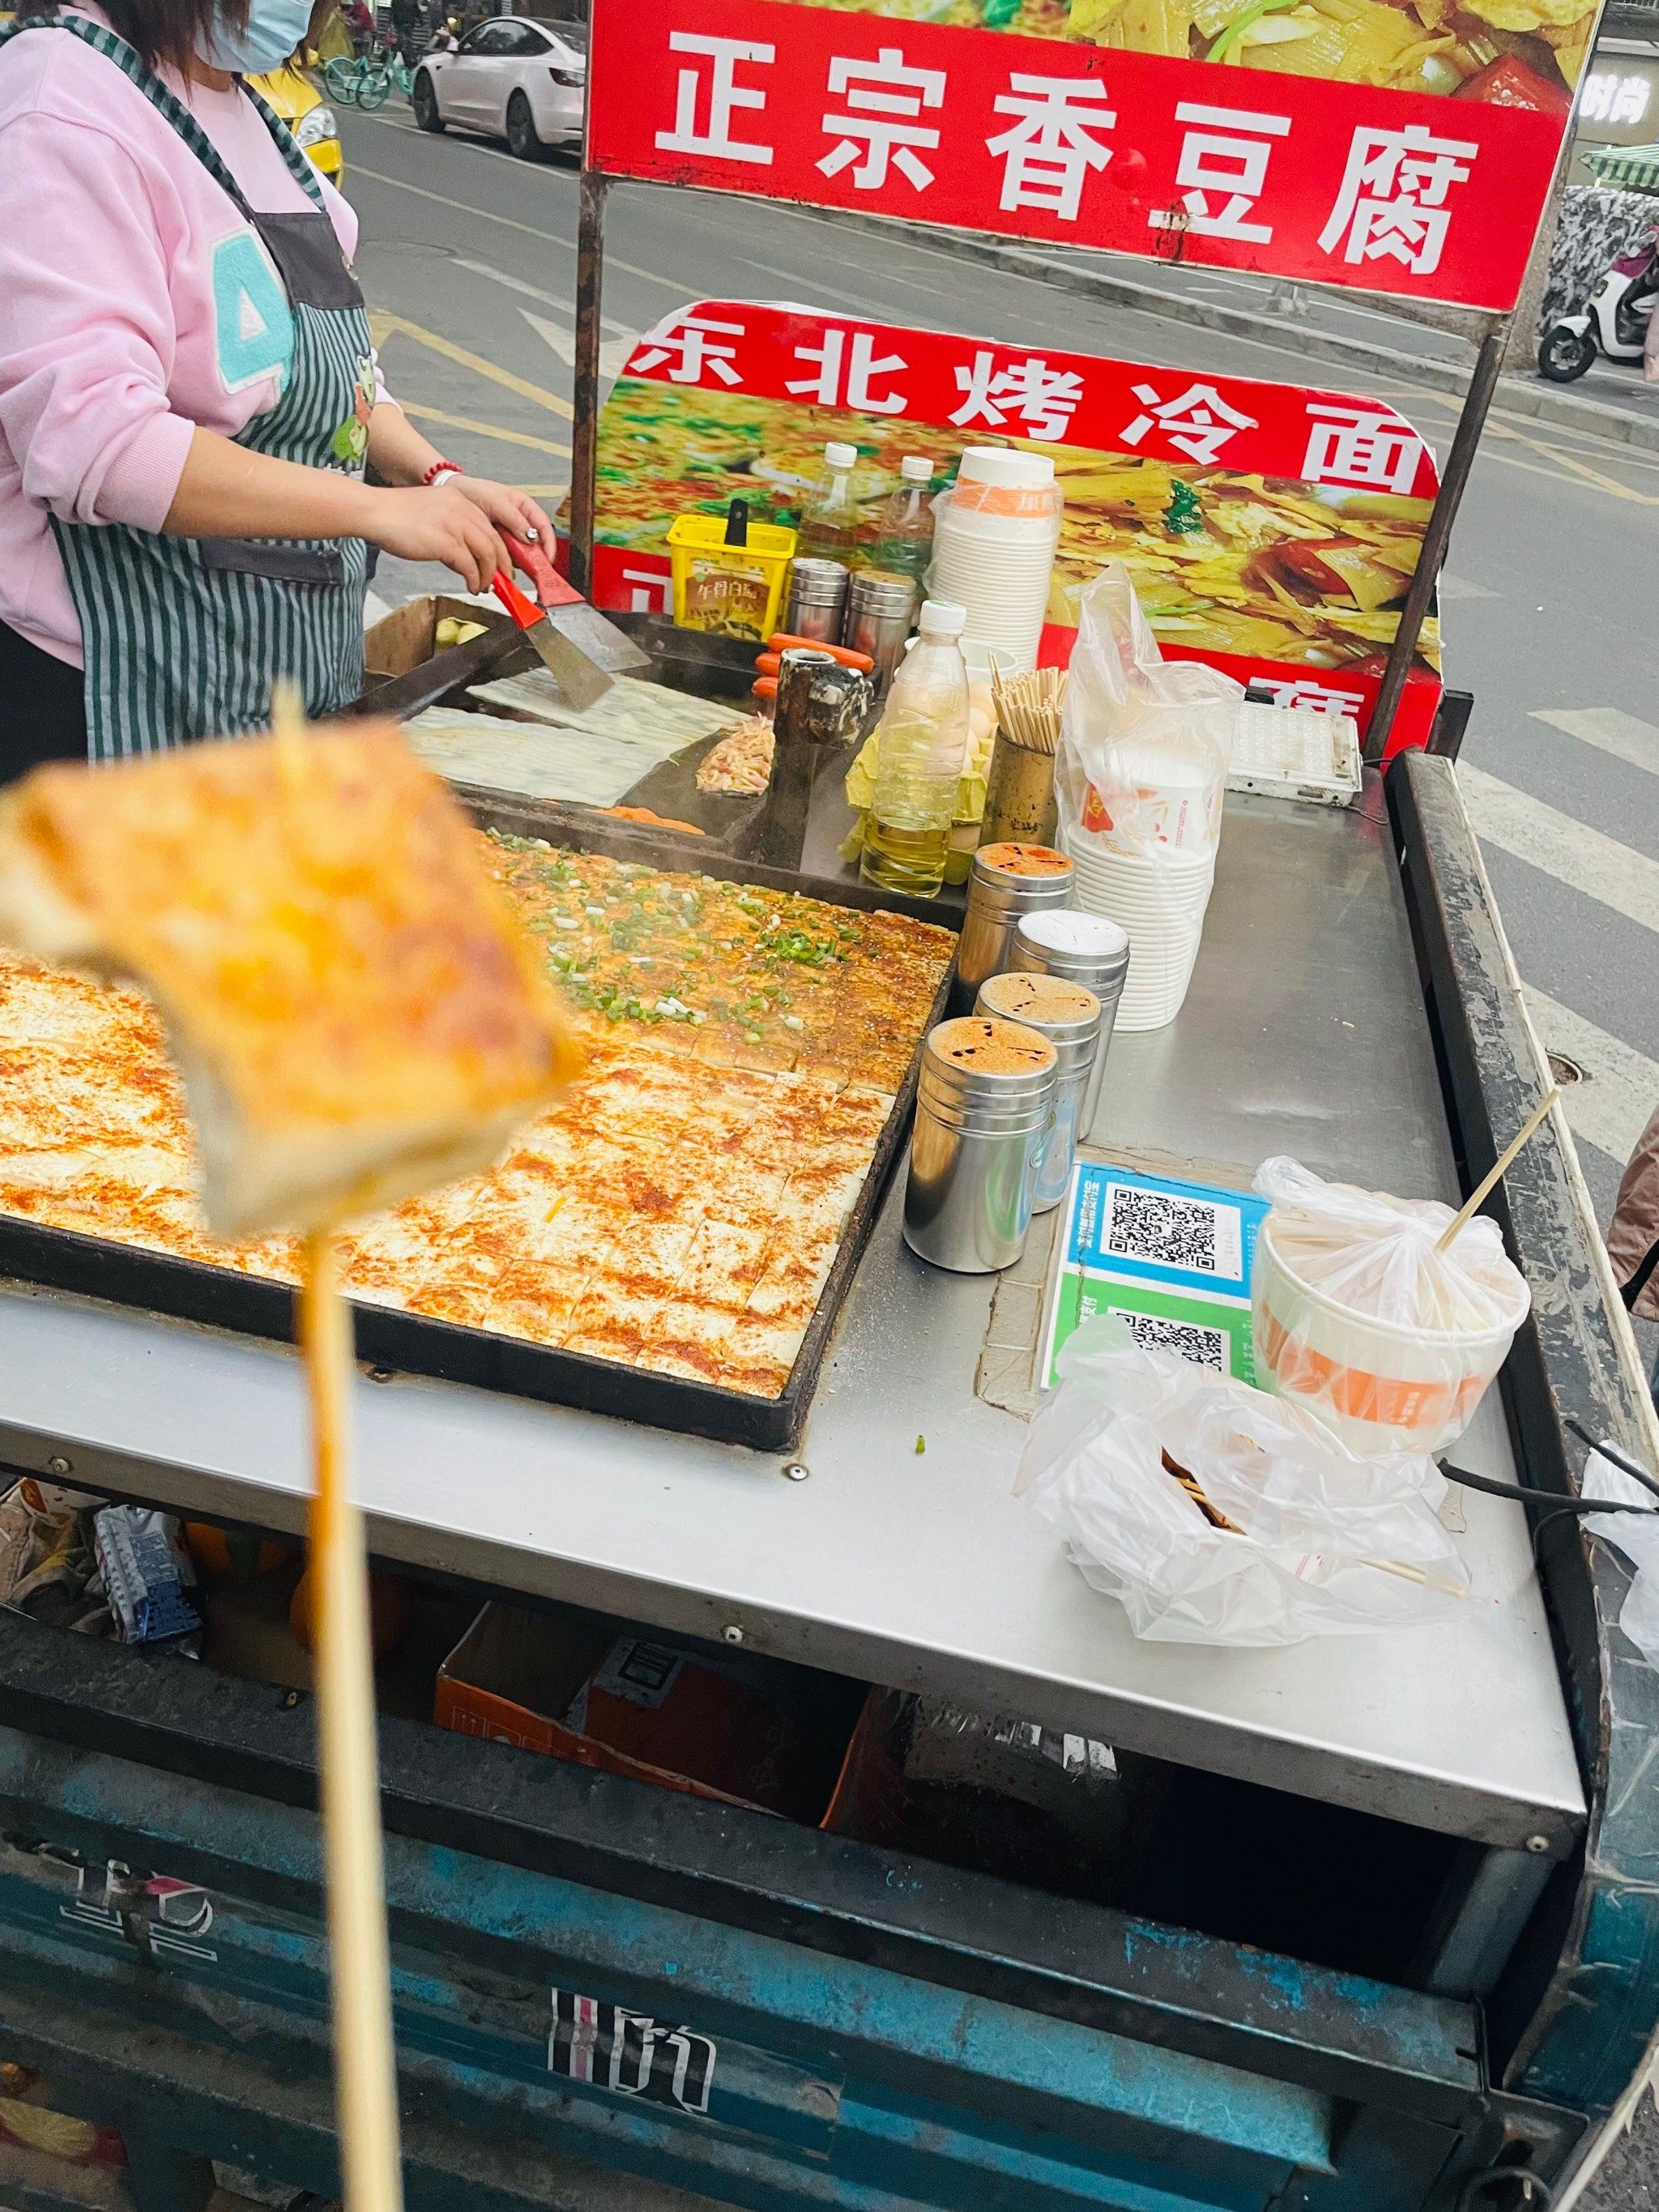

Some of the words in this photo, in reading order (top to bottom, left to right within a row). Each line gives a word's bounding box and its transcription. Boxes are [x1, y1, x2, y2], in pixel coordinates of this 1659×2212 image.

[654, 30, 1479, 275] 正宗香豆腐
[1578, 75, 1651, 124] 时尚
[629, 314, 1425, 495] 东北烤冷面
